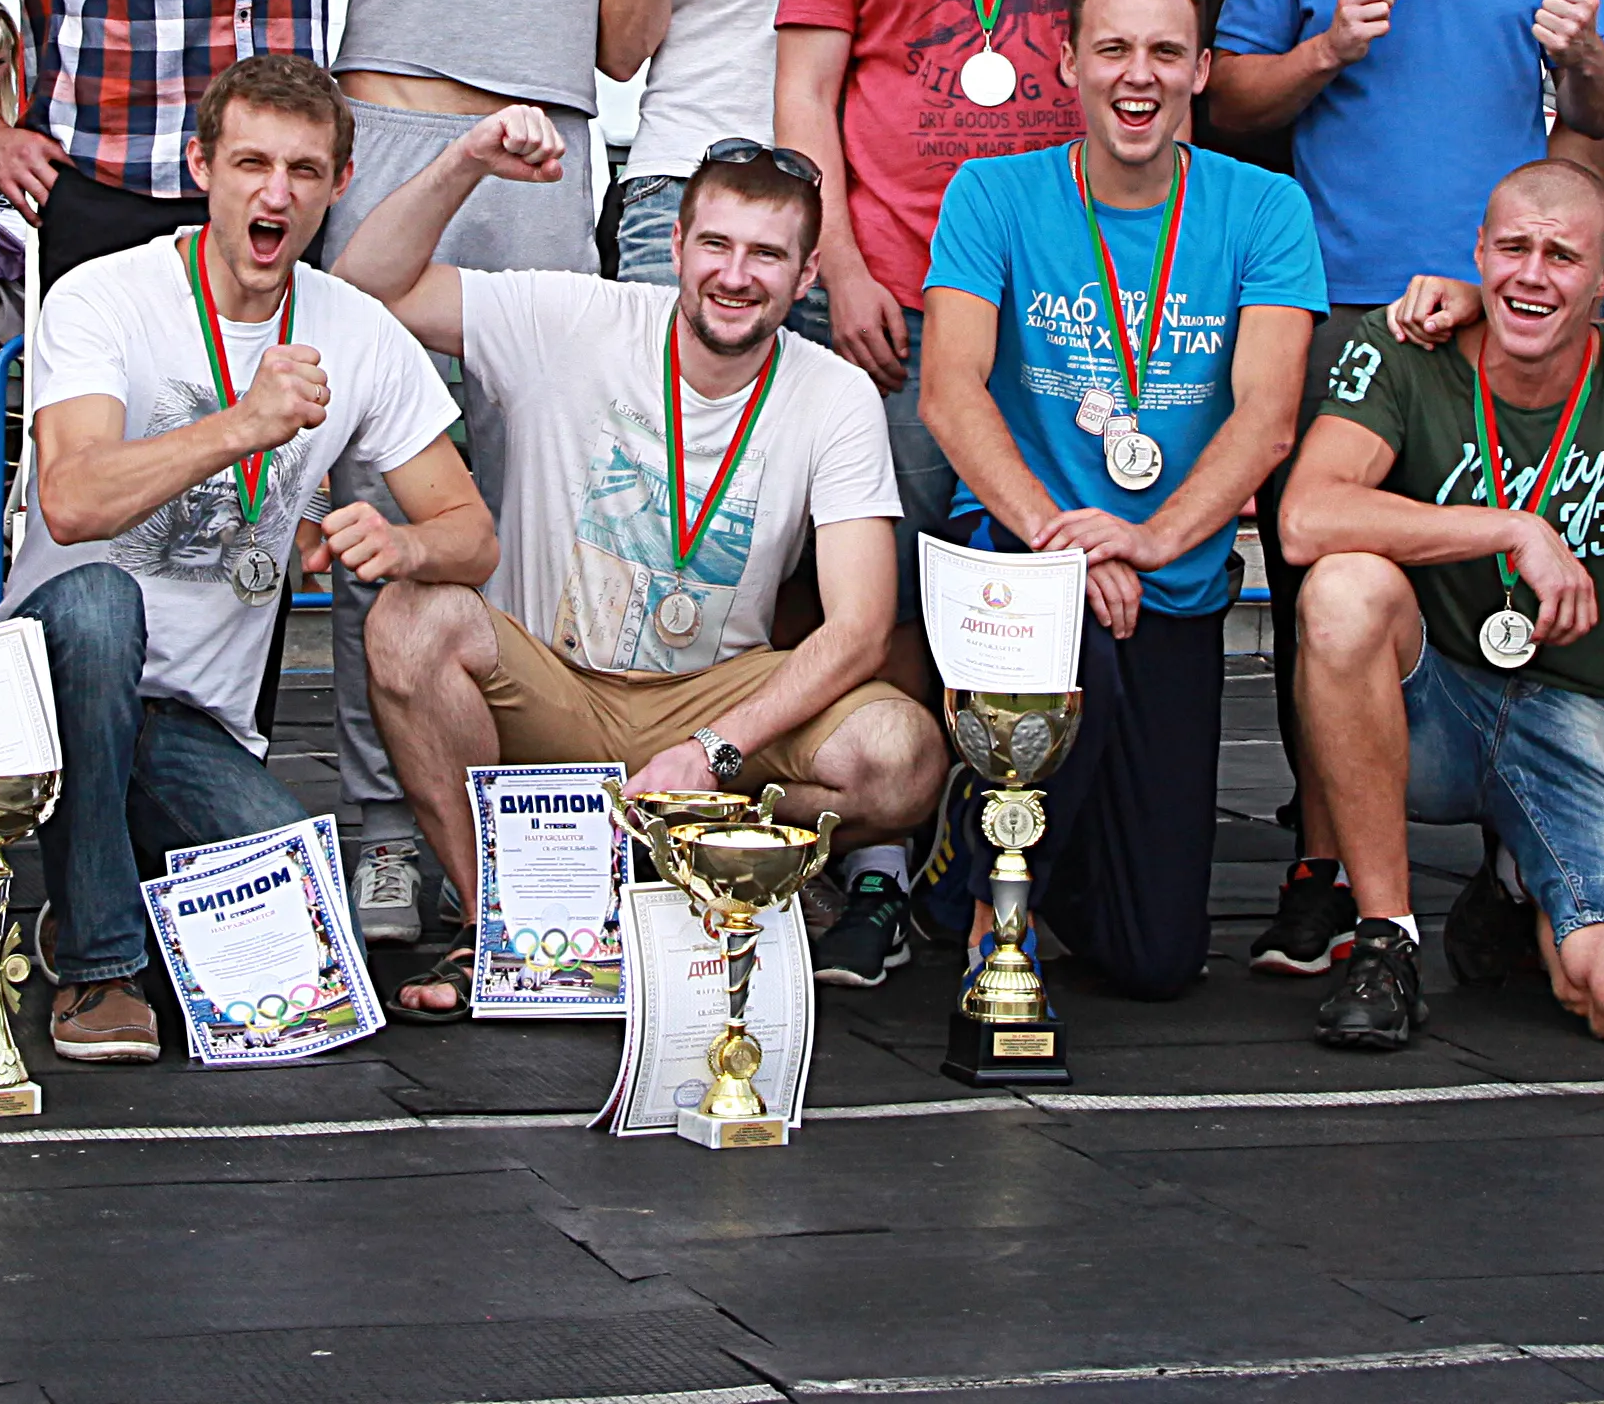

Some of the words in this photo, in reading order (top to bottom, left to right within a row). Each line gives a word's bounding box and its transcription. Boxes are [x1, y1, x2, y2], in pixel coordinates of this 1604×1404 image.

[904, 50, 1042, 103] SAILG
[919, 112, 948, 129] DRY
[954, 111, 1010, 129] GOODS
[1016, 110, 1082, 128] SUPPLIES
[917, 141, 970, 158] UNION
[976, 140, 1016, 156] MADE
[1027, 289, 1097, 323] XIAO
[1120, 299, 1179, 328] IAN
[1179, 315, 1203, 327] XIAO
[1204, 315, 1226, 327] TIAN
[1026, 314, 1057, 331] XIAO
[1059, 321, 1093, 336] TIAN
[1046, 333, 1067, 346] XIAO
[1169, 331, 1223, 355] TIAN
[609, 399, 618, 410] A
[618, 404, 652, 428] SIMPLE
[1082, 410, 1105, 424] SCOTT
[1108, 429, 1129, 437] JEREM
[623, 627, 637, 653] OLD
[630, 571, 650, 621] ISLAND
[960, 617, 1034, 639] ДИПЛОМ
[500, 794, 605, 814] ДИПЛОМ
[177, 866, 292, 917] ДИПЛОМ
[687, 955, 763, 981] ДИП
